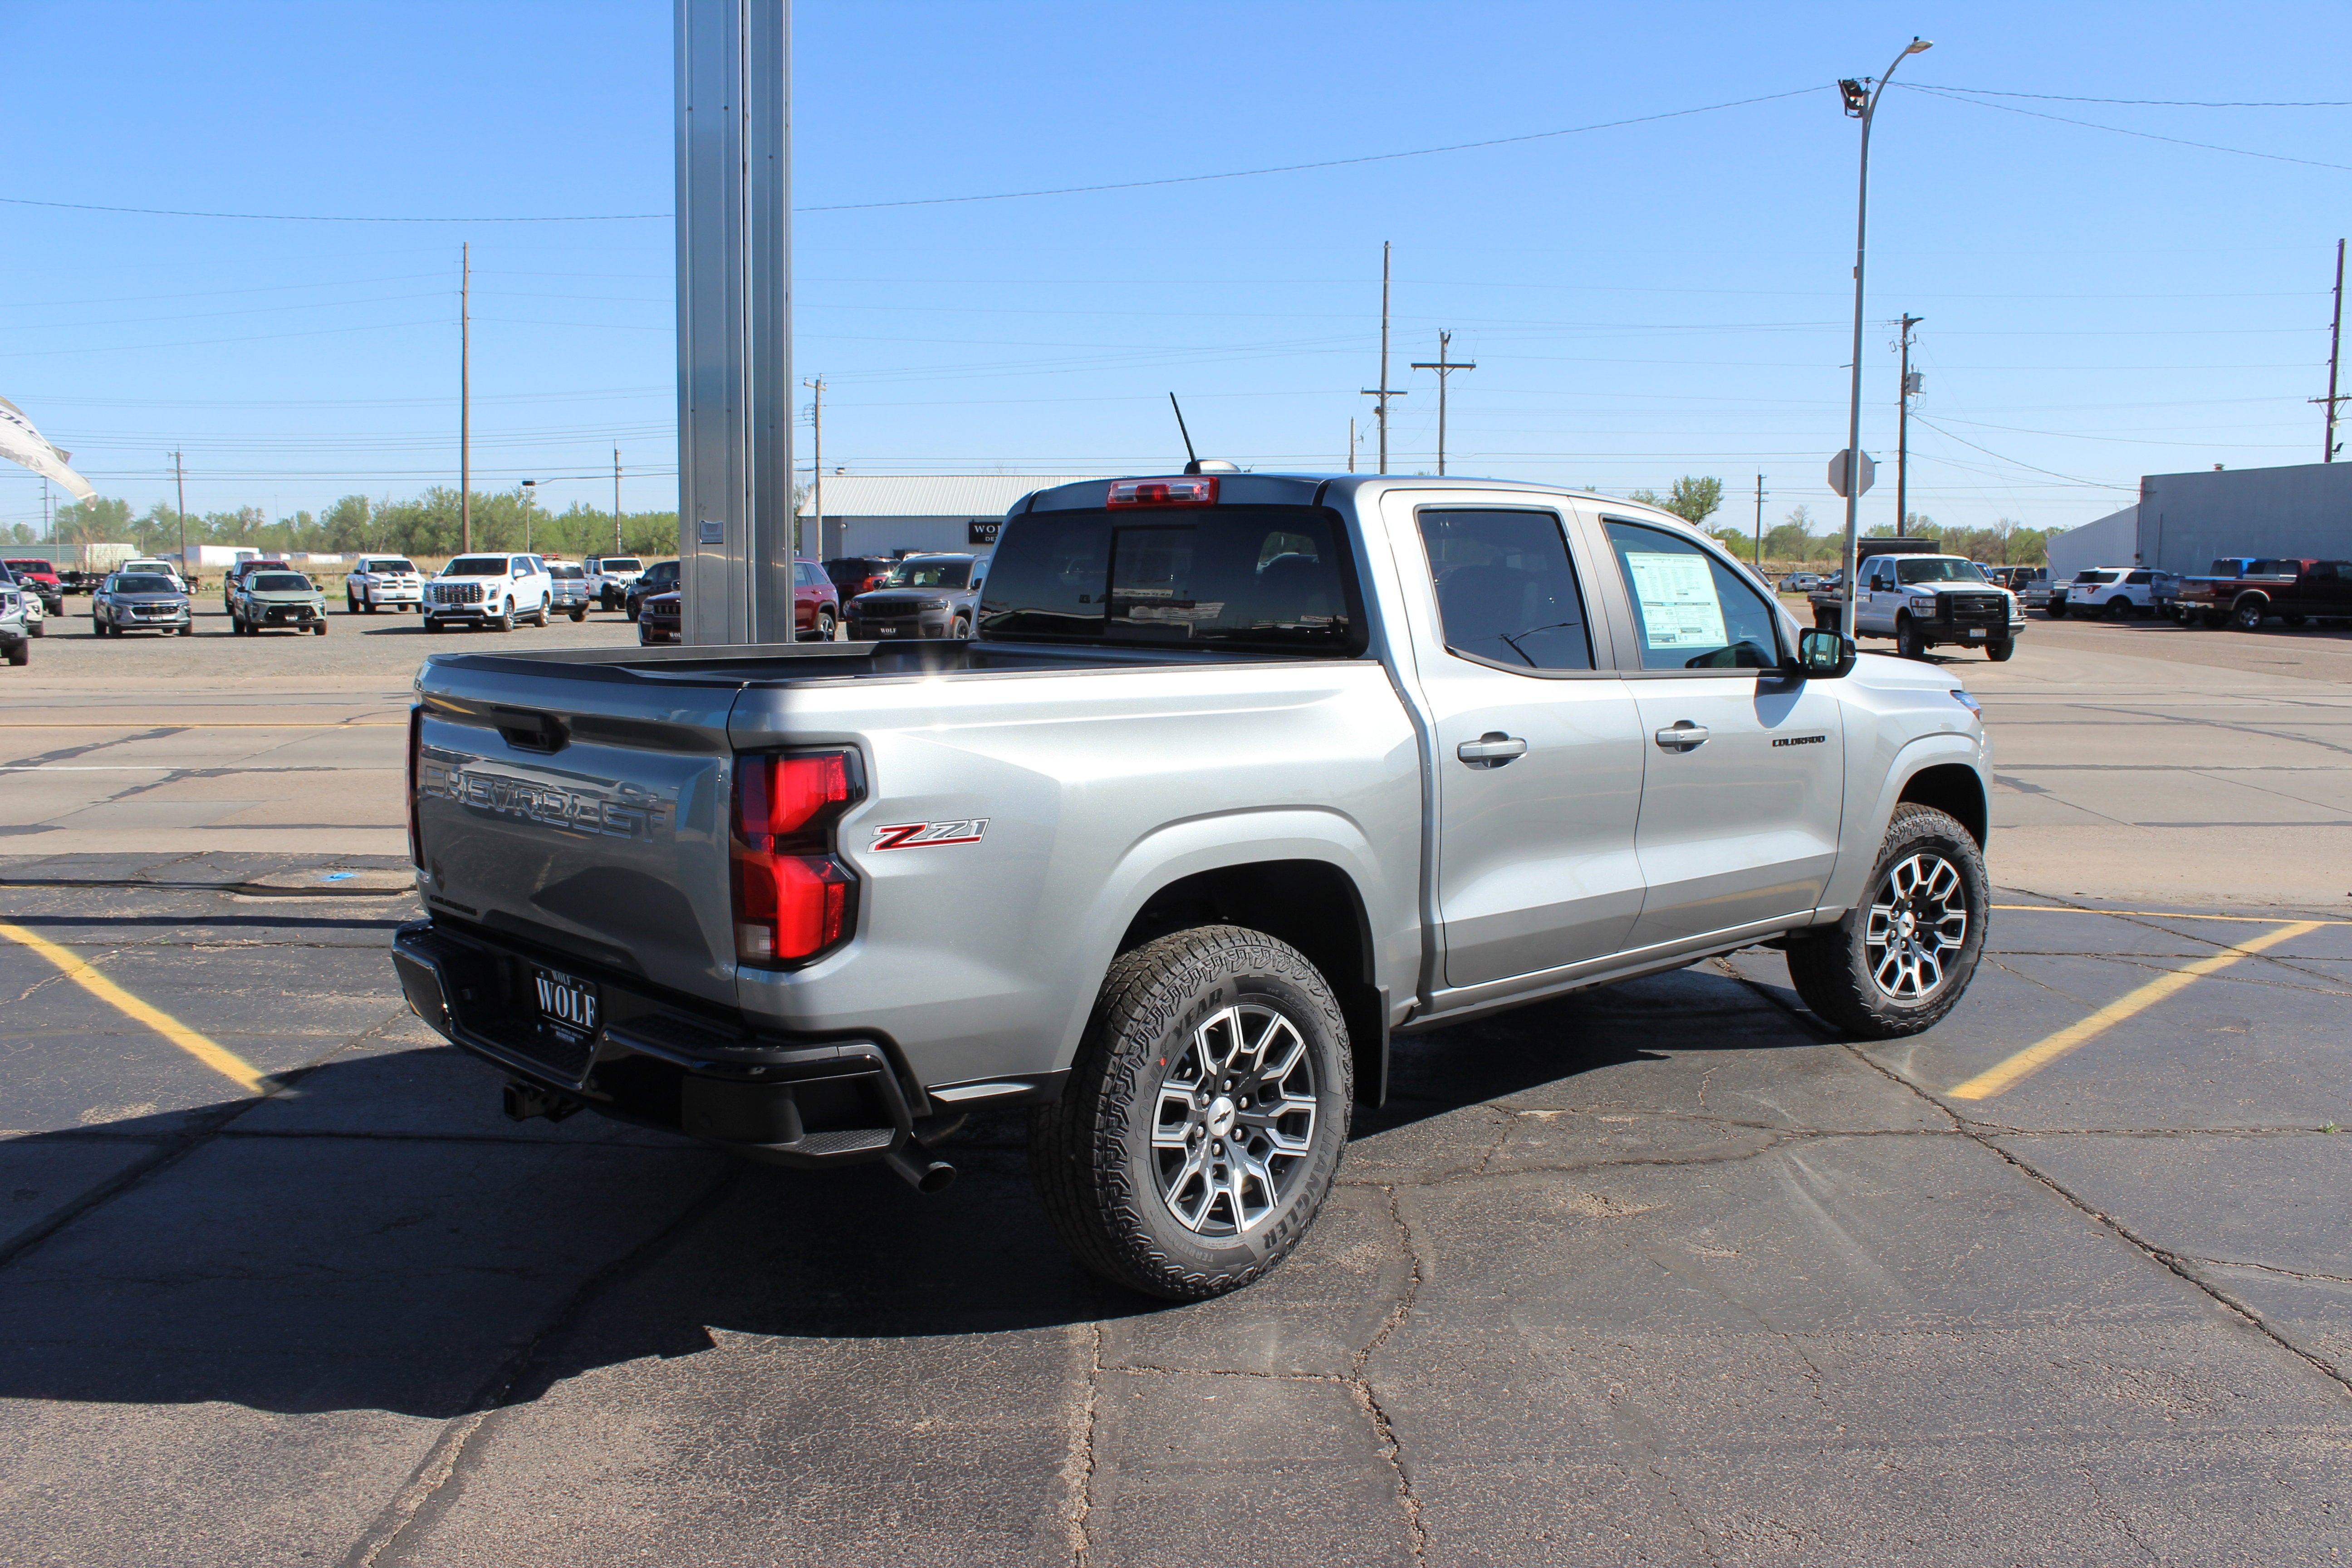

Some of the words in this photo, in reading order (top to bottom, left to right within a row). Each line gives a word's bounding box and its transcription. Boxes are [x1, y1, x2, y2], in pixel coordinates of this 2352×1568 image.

[1772, 735, 1825, 747] COLORADO
[425, 765, 666, 843] CHEVROLET
[866, 818, 990, 854] Z71
[552, 971, 570, 985] WOLF
[535, 977, 595, 1028] WOLF
[1262, 1112, 1339, 1250] WRANGLER
